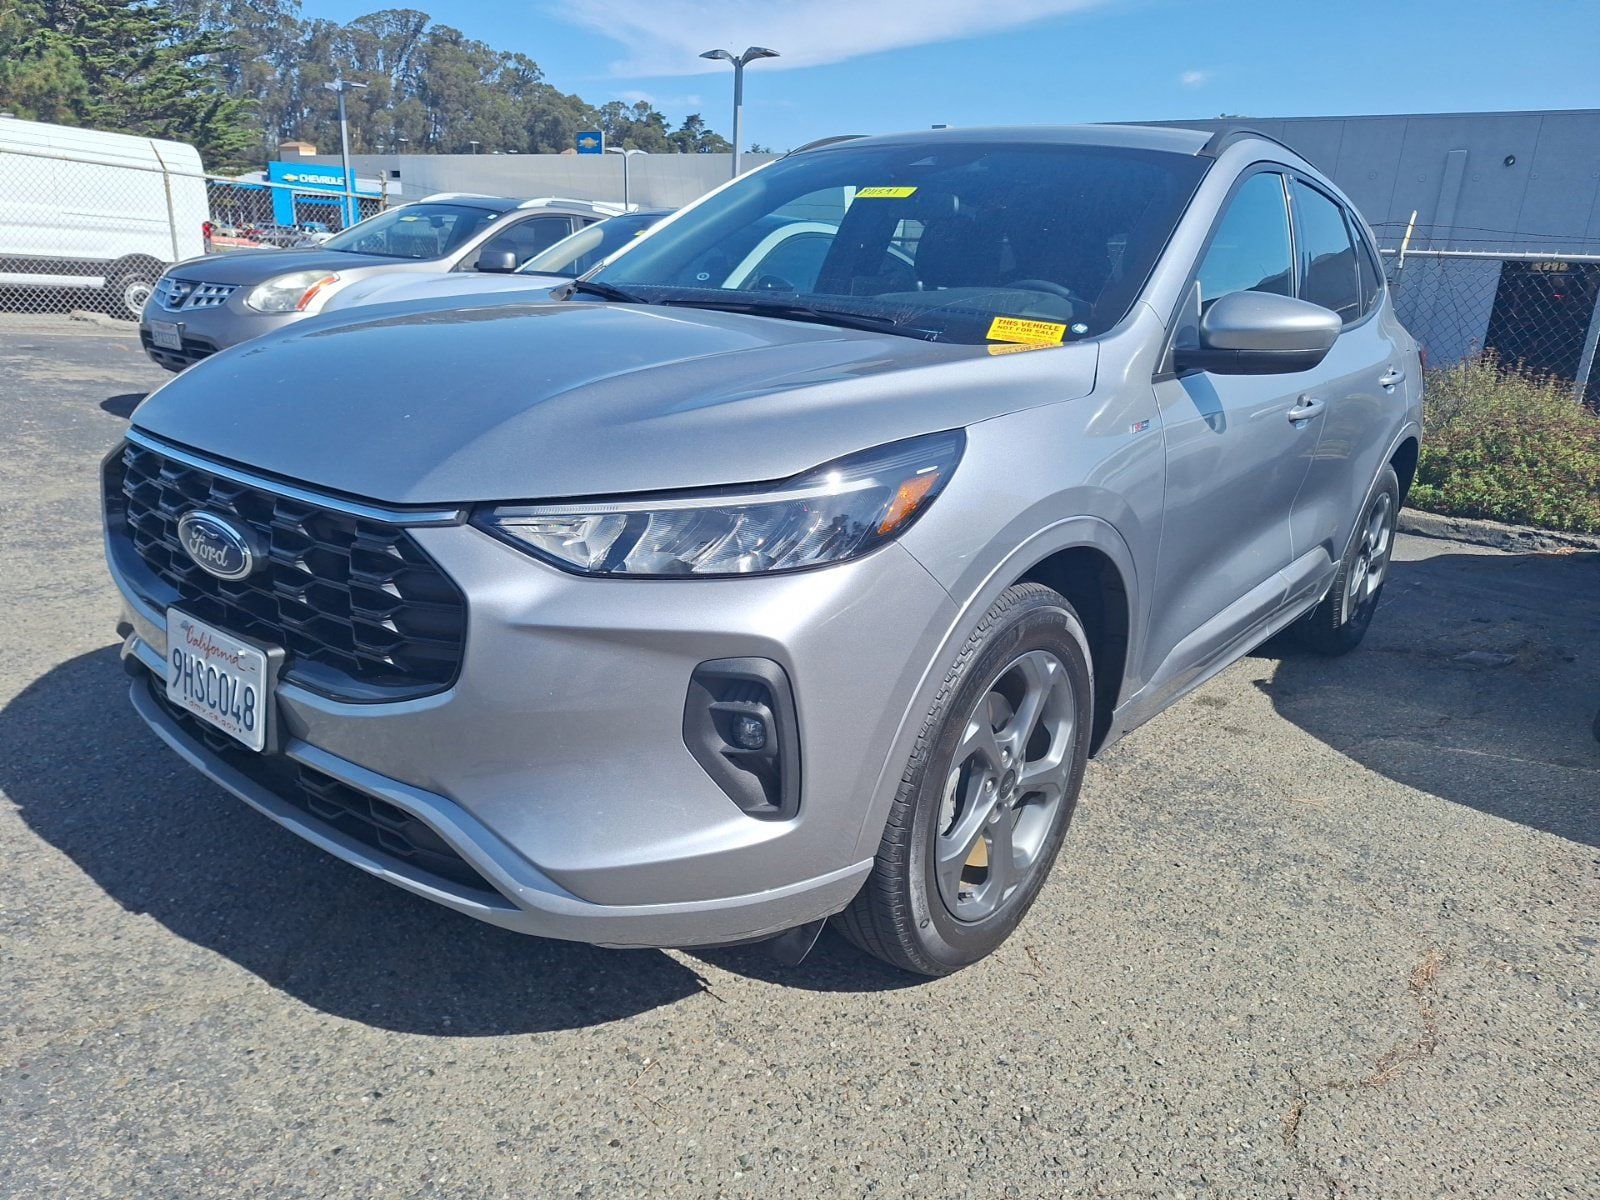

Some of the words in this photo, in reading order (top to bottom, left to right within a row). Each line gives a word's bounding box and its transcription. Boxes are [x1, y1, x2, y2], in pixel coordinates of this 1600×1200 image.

[300, 174, 345, 185] CHEVROLE
[998, 319, 1018, 327] THIS
[1021, 320, 1060, 331] VEHICLE
[189, 525, 228, 567] Ford
[185, 625, 245, 671] California
[172, 648, 255, 731] 9HSC048
